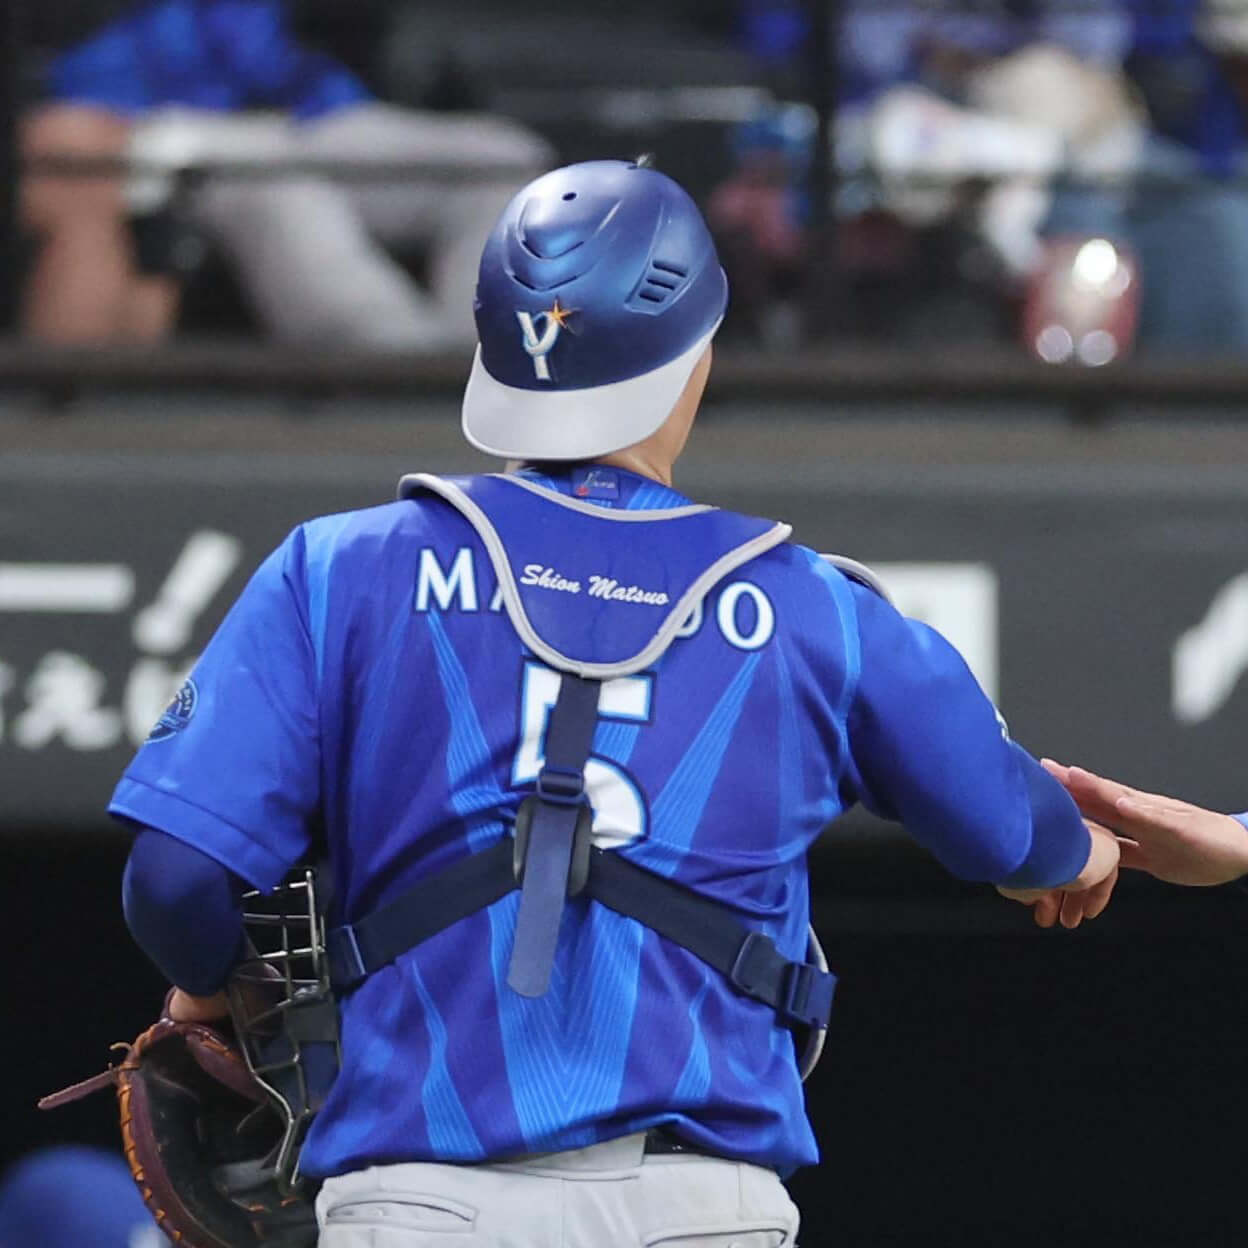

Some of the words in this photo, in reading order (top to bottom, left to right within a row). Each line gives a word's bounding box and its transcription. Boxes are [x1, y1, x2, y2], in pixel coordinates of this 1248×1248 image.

[520, 564, 582, 594] Shion
[588, 575, 670, 606] Matsuo
[511, 661, 655, 849] 5
